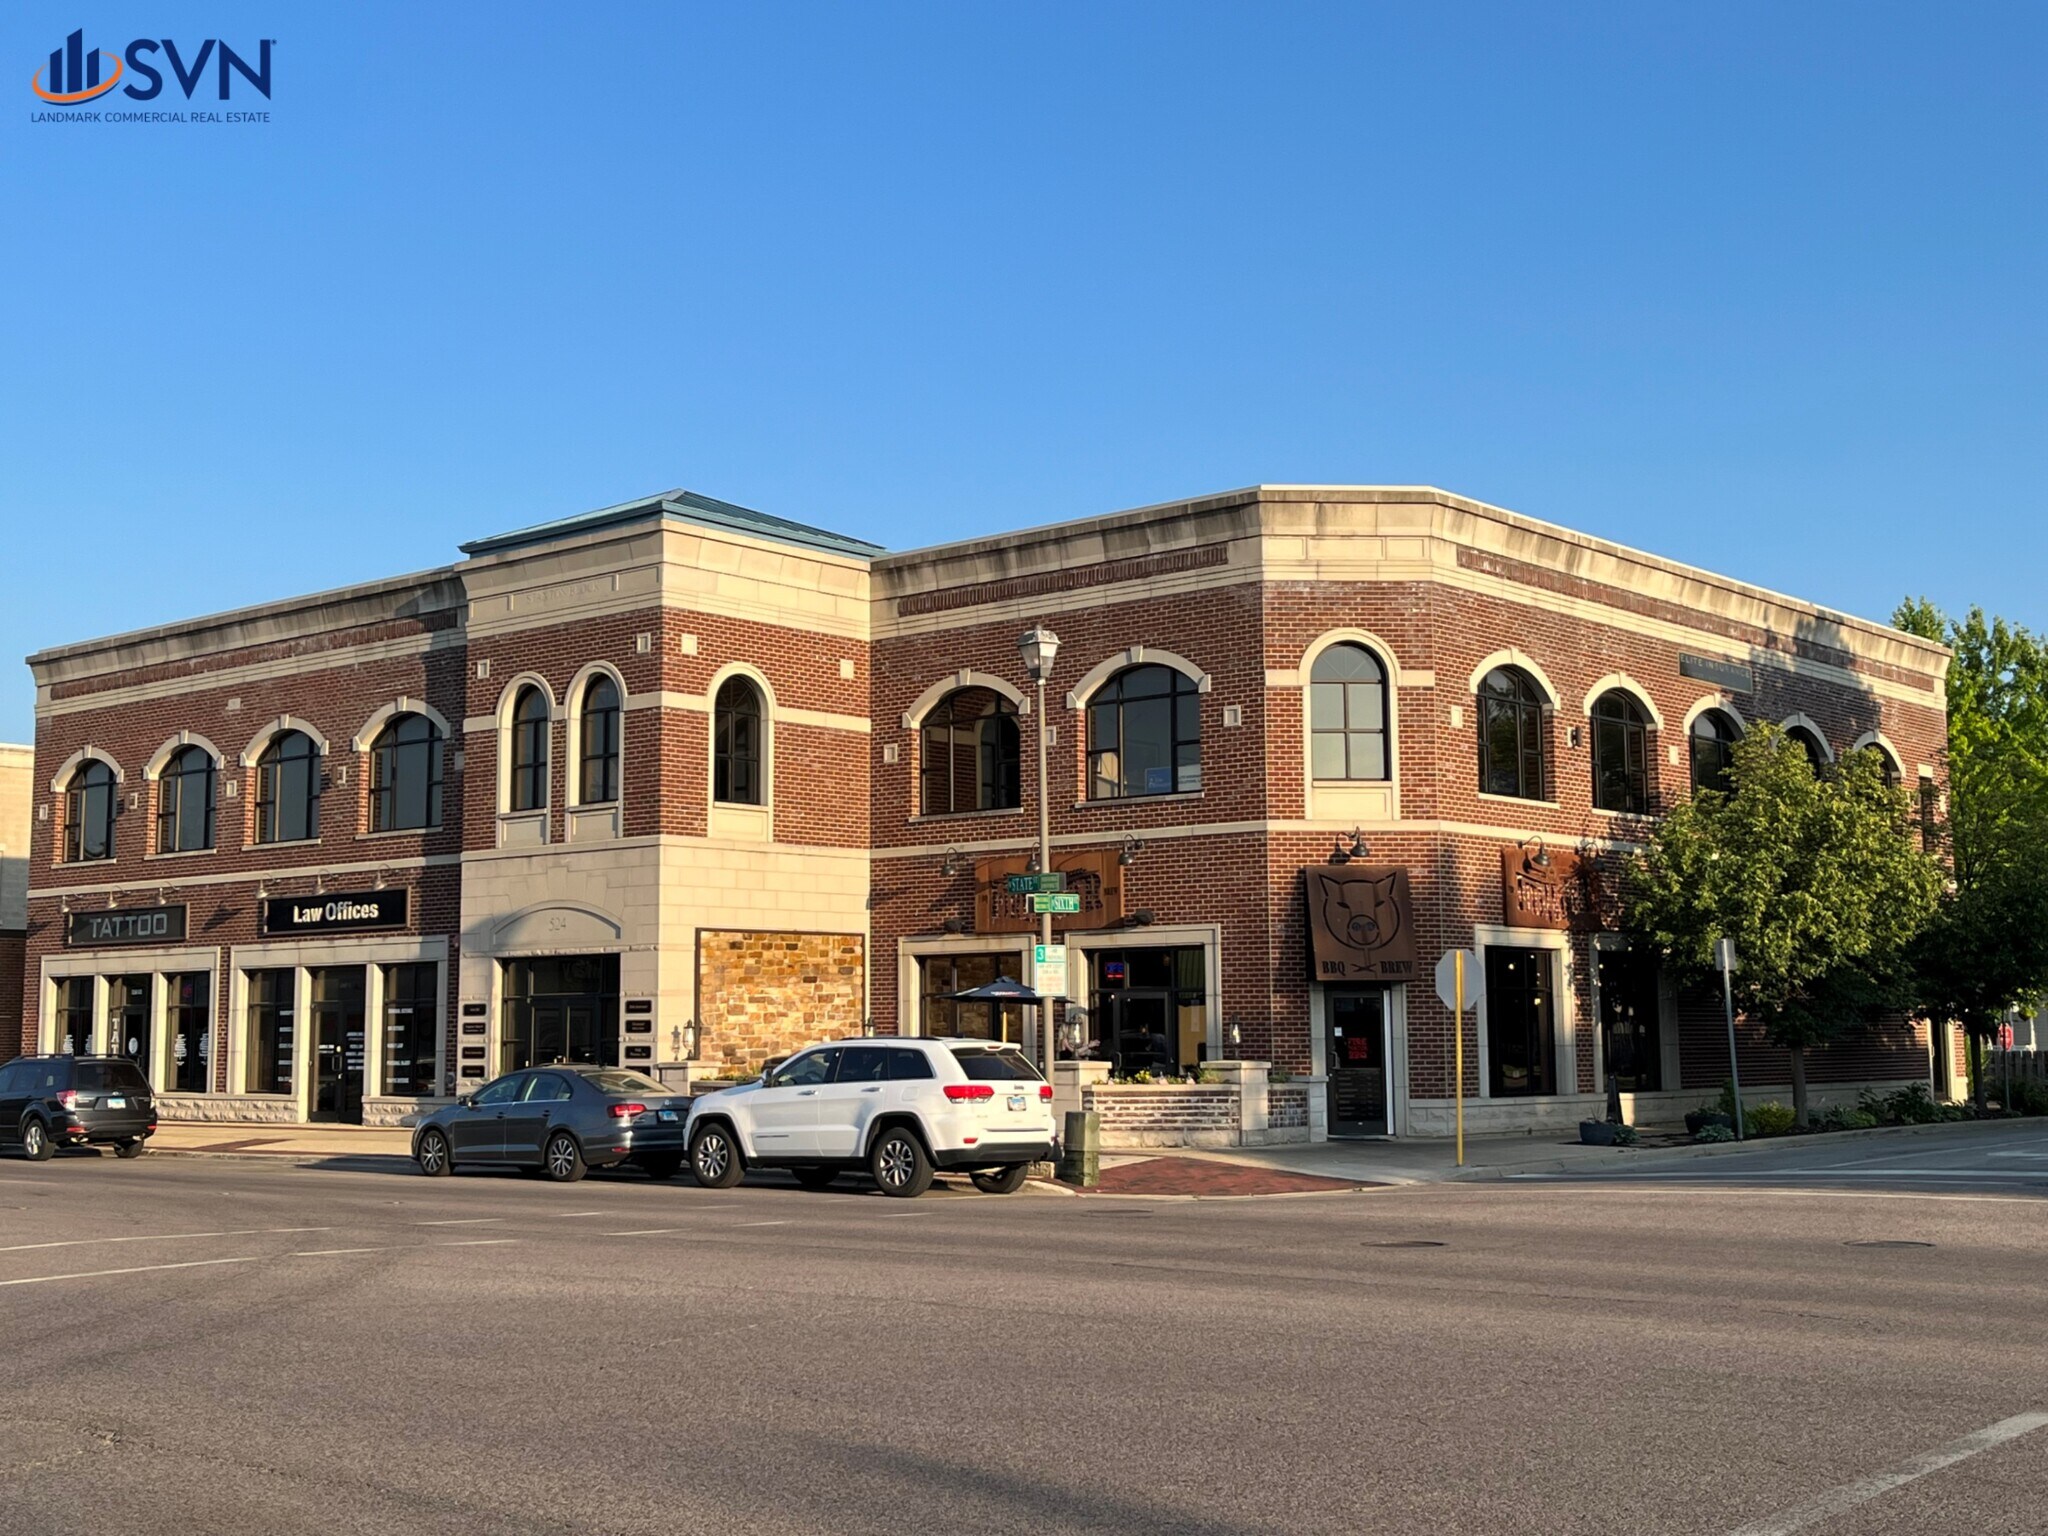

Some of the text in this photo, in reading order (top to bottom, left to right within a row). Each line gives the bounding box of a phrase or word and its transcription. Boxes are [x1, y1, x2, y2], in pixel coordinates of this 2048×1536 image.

[1680, 654, 1703, 667] ELITE
[1011, 876, 1034, 892] STATE
[1054, 896, 1074, 910] SIXTH
[293, 901, 379, 923] Law Offices
[89, 913, 168, 939] TATTOO
[548, 916, 567, 932] 524
[1037, 948, 1045, 960] 3
[1322, 960, 1413, 976] BBQ BREW
